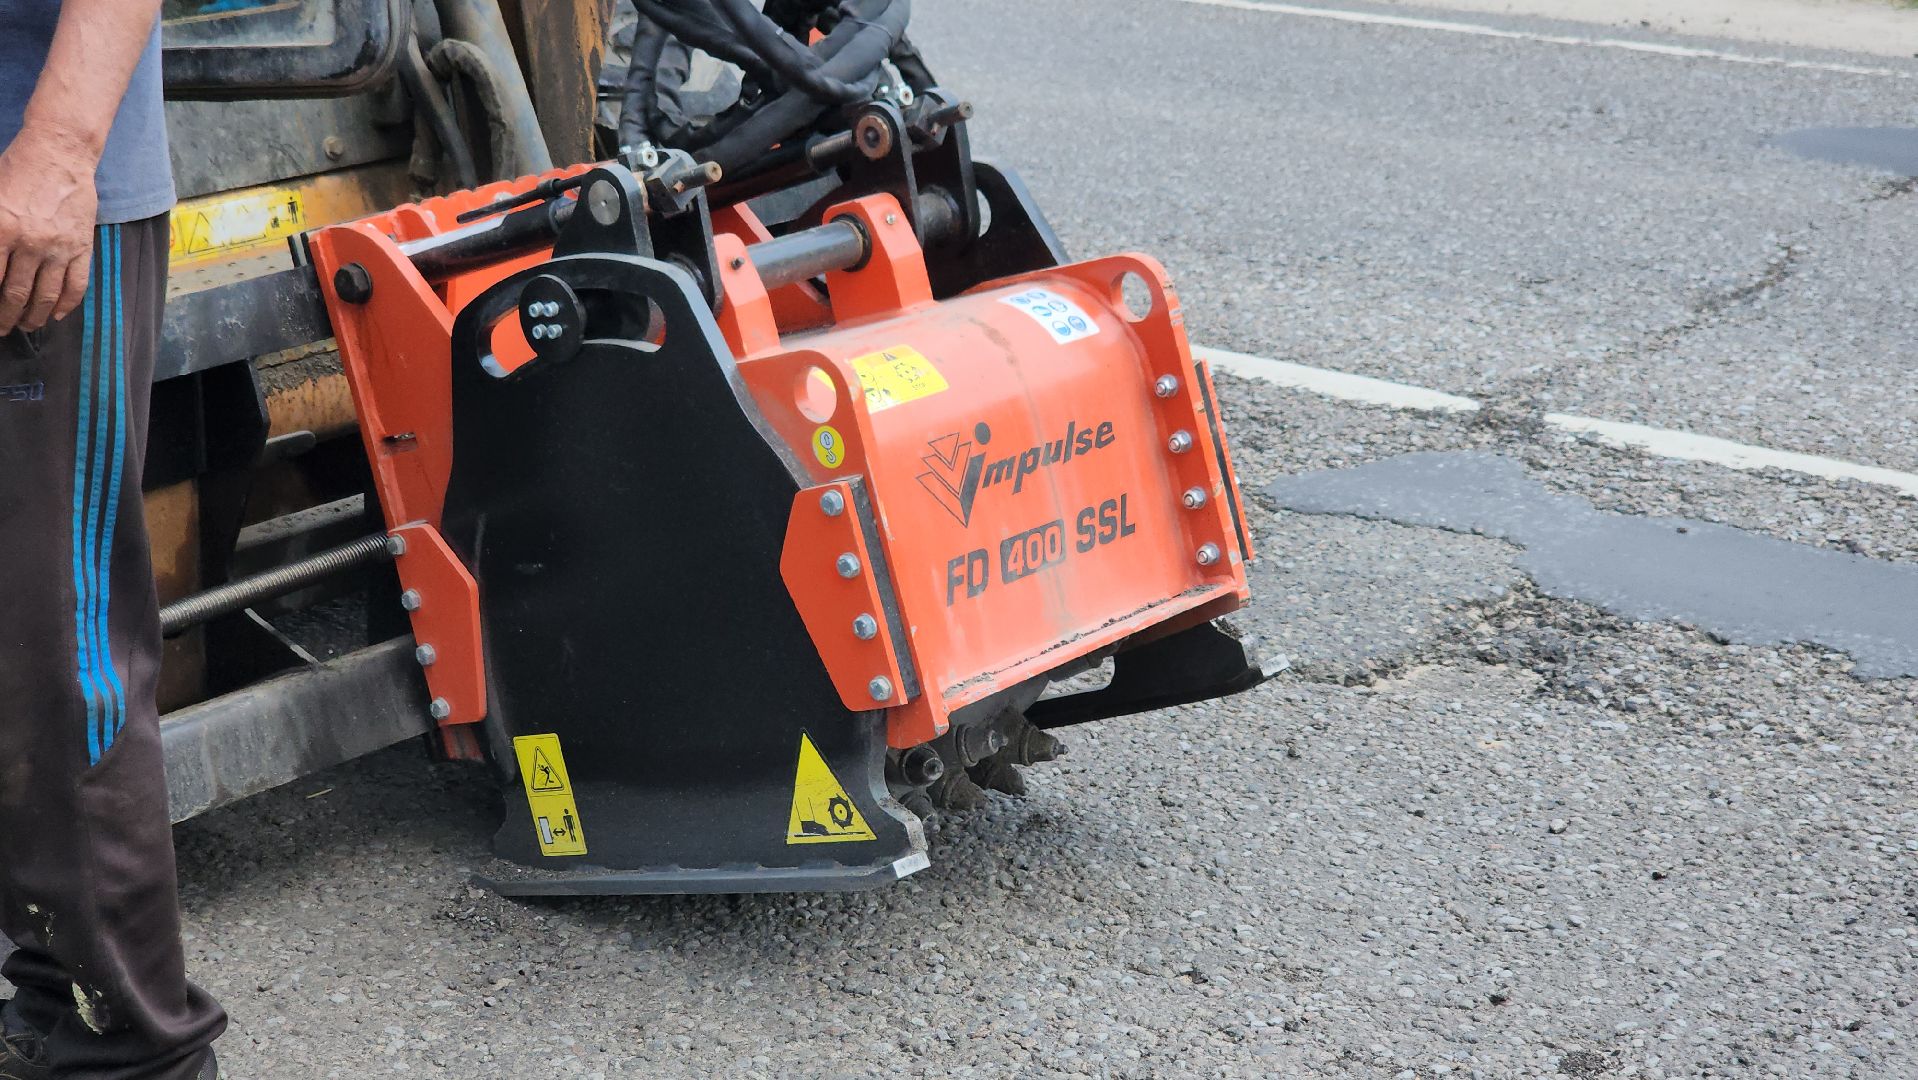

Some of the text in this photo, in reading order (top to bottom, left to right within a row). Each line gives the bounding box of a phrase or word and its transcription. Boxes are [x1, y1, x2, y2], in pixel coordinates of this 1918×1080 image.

[946, 493, 1136, 607] FD 400 SSL
